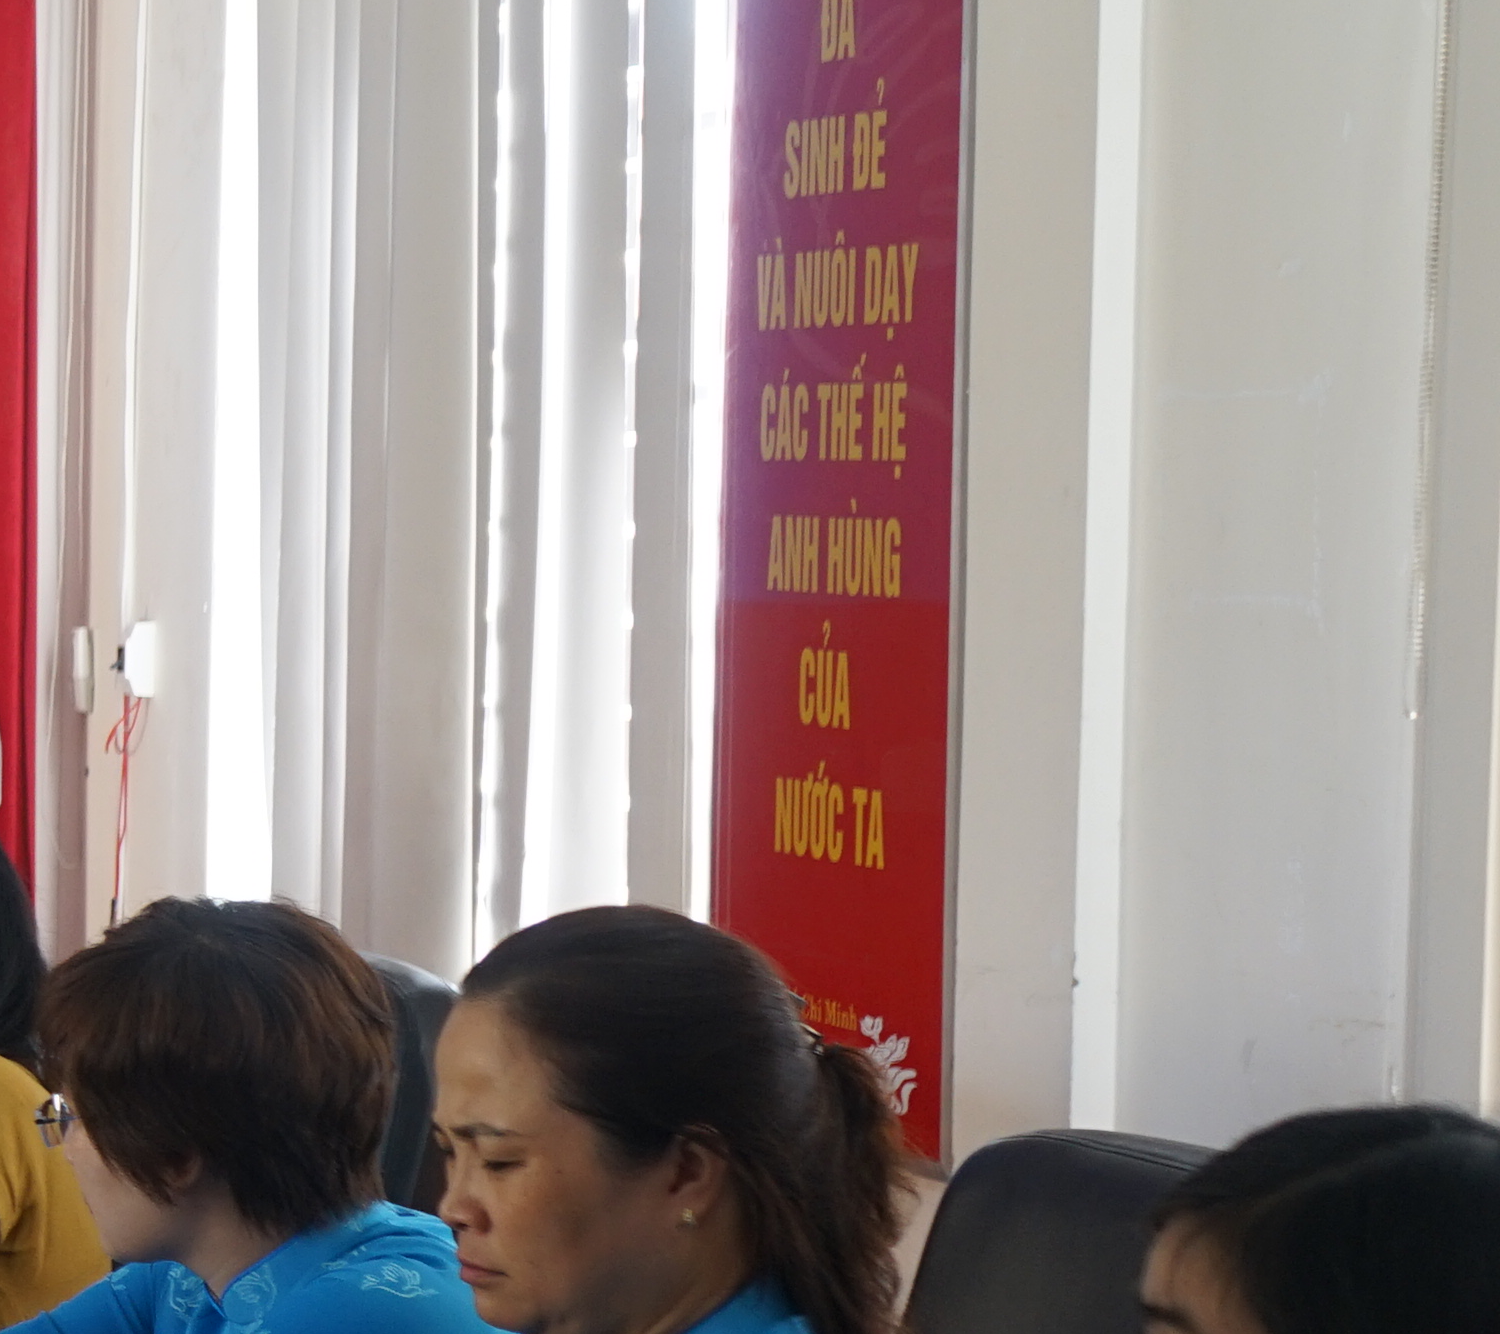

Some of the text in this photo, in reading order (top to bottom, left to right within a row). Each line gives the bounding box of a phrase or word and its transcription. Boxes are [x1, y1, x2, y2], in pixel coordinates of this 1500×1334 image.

[783, 78, 888, 200] SINH ĐẺ
[757, 231, 920, 342] VÀ NUÔI DẠY
[760, 354, 908, 480] CÁC THẾ HỆ
[767, 498, 902, 599] ANH HÙNG
[798, 619, 851, 731] CỦA
[774, 760, 886, 871] NƯỚC TA
[825, 997, 858, 1032] Minh
